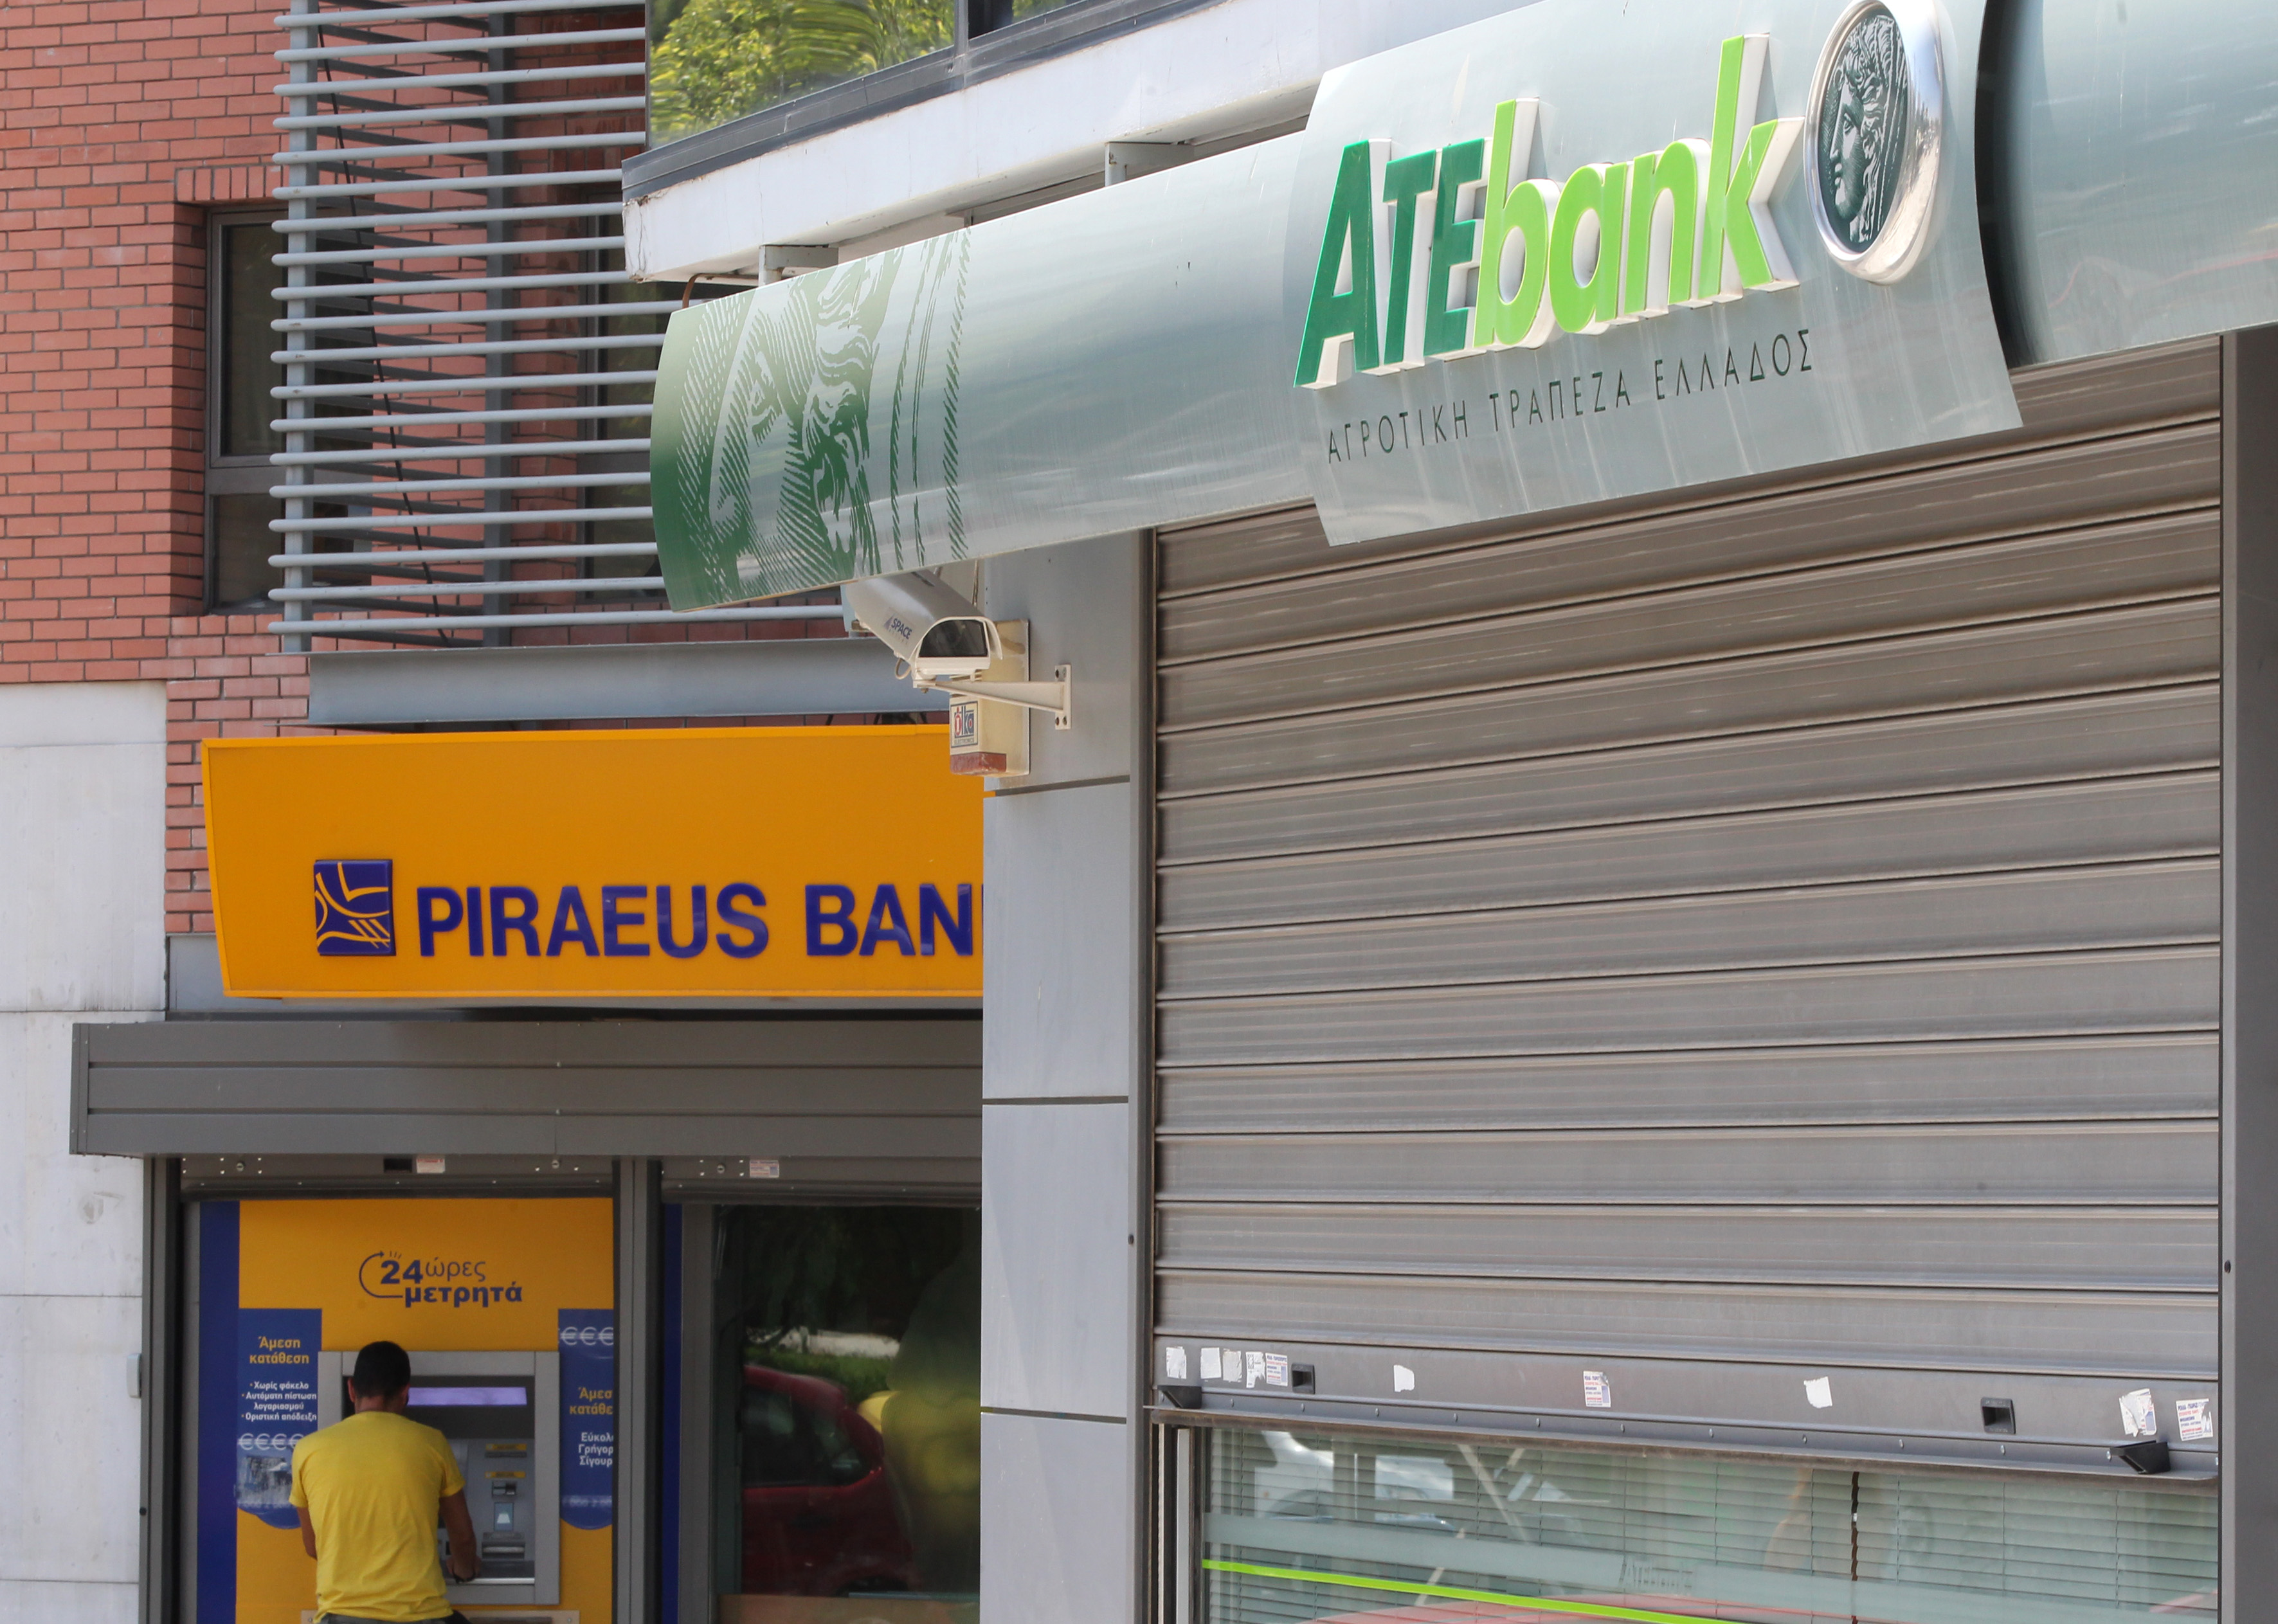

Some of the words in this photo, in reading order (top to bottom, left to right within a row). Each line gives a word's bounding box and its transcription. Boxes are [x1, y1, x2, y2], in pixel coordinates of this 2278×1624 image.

[1294, 33, 1802, 390] ATEbank
[1328, 400, 1469, 464] ΑΓΡΟΤΙΚΗ
[1489, 369, 1631, 432] ΤΡΑΠΕΖΑ
[1654, 329, 1812, 401] ΕΛΛΑΔΟΣ
[891, 618, 912, 640] SPACE
[416, 883, 770, 959] PIRAEUS
[804, 883, 984, 957] BAN
[405, 1281, 522, 1308] μετρητά
[258, 1337, 301, 1351] Άμεση
[249, 1352, 309, 1364] κατάθεση
[254, 1381, 278, 1391] Χωρίς
[279, 1381, 309, 1391] φάκελο
[246, 1391, 283, 1401] Αυτόματη
[253, 1402, 303, 1411] λογαριασμού
[246, 1412, 280, 1422] Οριστική
[282, 1412, 317, 1422] απόδειξη
